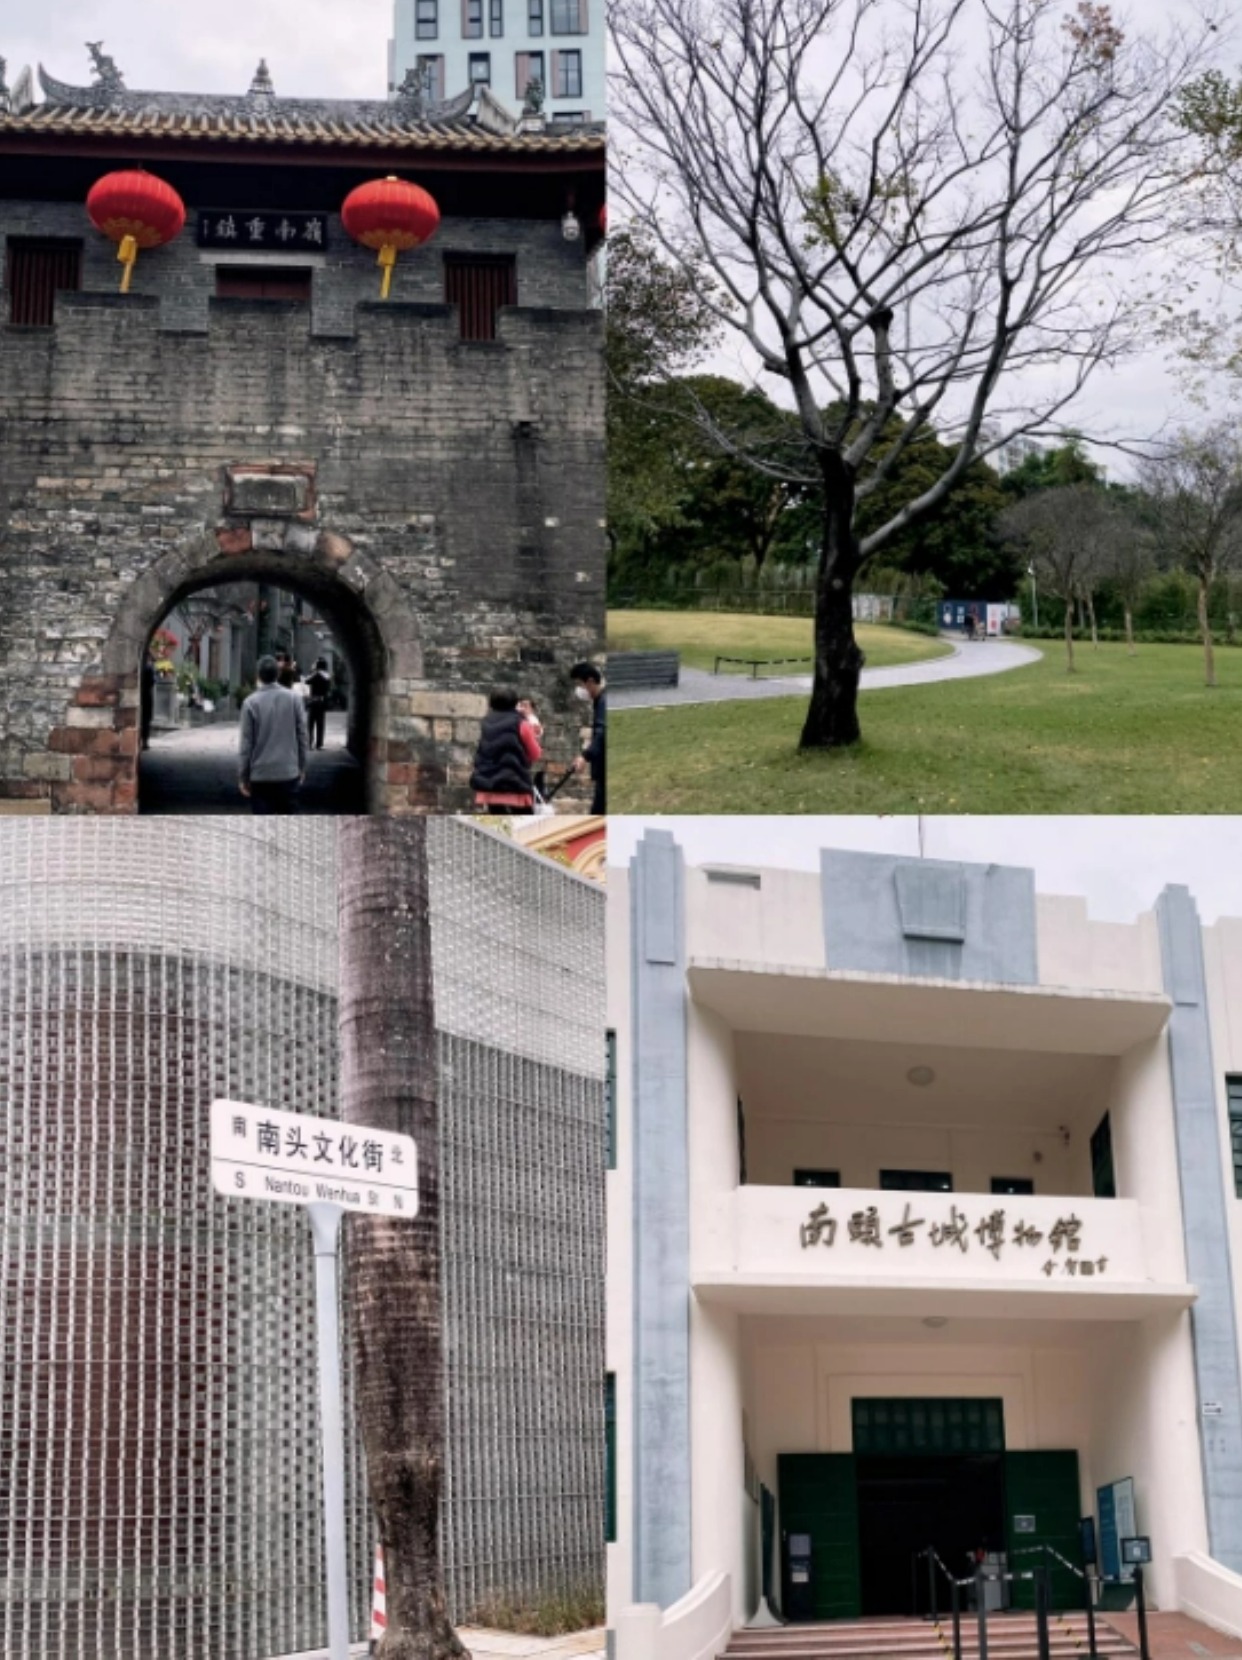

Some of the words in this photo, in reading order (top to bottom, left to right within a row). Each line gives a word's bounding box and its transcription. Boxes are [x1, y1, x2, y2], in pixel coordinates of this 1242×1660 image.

[232, 1115, 247, 1138] 南
[256, 1119, 384, 1173] 南头文化街
[390, 1144, 405, 1165] 北
[234, 1171, 246, 1189] S
[265, 1175, 309, 1197] Nantou
[316, 1183, 361, 1204] Wenhua
[394, 1194, 404, 1210] N
